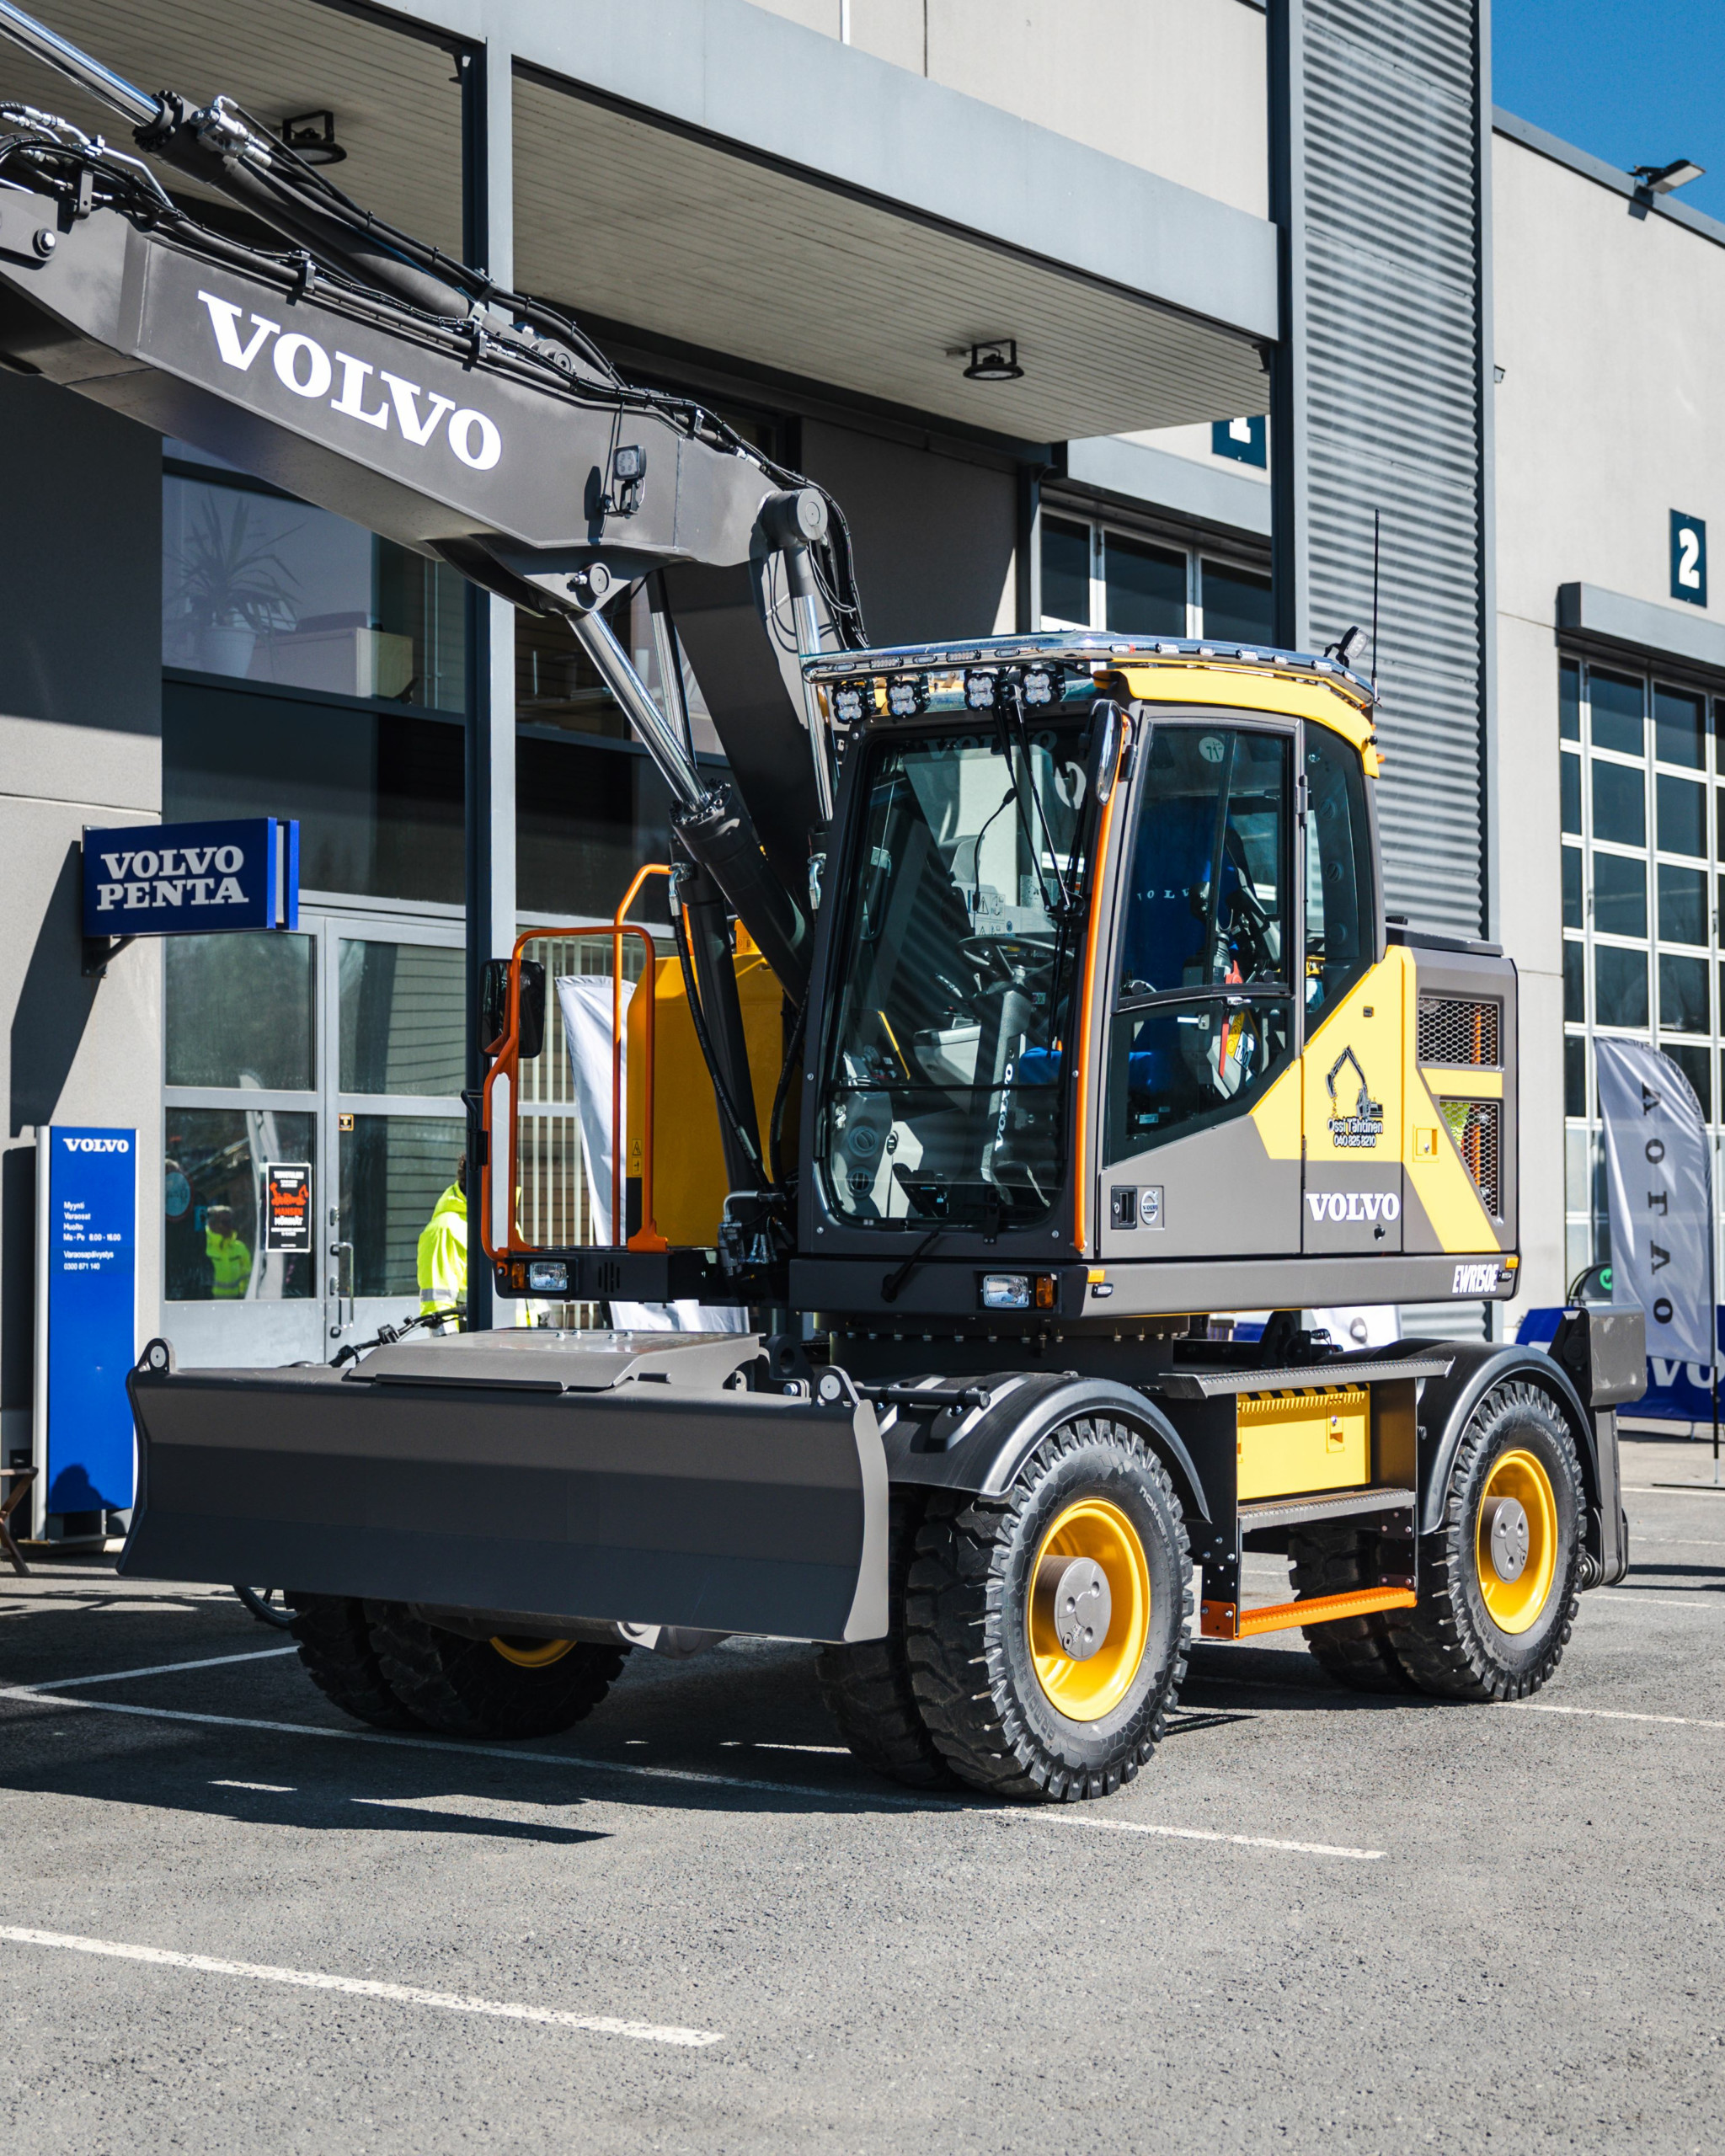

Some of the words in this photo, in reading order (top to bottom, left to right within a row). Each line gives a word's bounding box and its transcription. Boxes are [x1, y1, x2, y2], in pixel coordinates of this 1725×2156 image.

[197, 290, 503, 471] VOLVO
[1679, 528, 1701, 589] 2
[100, 846, 244, 879] VOLVO
[96, 877, 249, 910] PENTA
[1327, 1118, 1346, 1133] Ossi
[1347, 1117, 1383, 1134] Tähtinen
[63, 1138, 129, 1153] VOLVO
[1334, 1134, 1348, 1147] 040
[1348, 1134, 1360, 1147] 825
[1361, 1134, 1376, 1147] 8210
[63, 1201, 85, 1211] Myynti
[63, 1212, 91, 1220] Varaosat
[1306, 1192, 1400, 1221] VOLVO
[63, 1222, 83, 1230] Huolto
[1452, 1263, 1499, 1294] EWR150E
